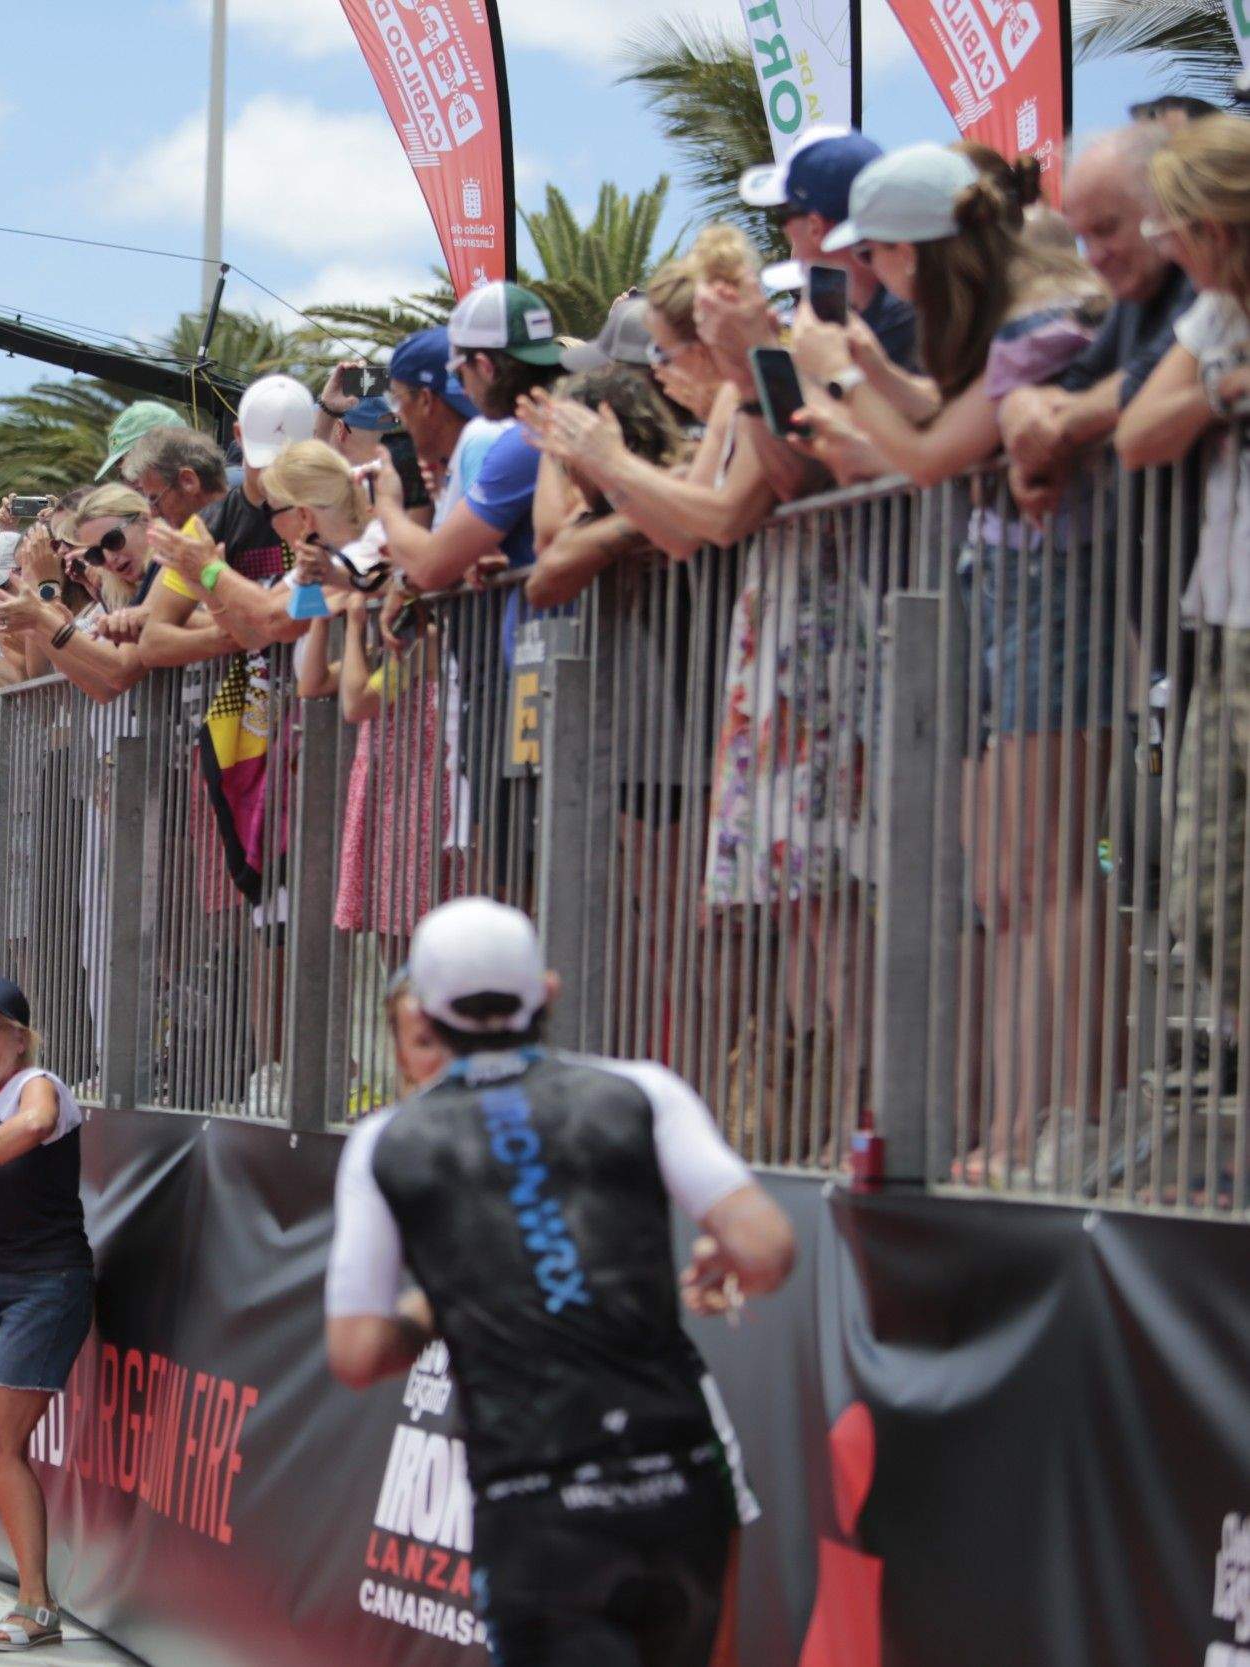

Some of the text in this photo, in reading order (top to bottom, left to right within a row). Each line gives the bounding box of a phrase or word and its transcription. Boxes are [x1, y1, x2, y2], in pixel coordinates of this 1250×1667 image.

[178, 1371, 259, 1546] FIRE
[373, 1423, 474, 1554] IRON
[365, 1531, 472, 1600] LANZA
